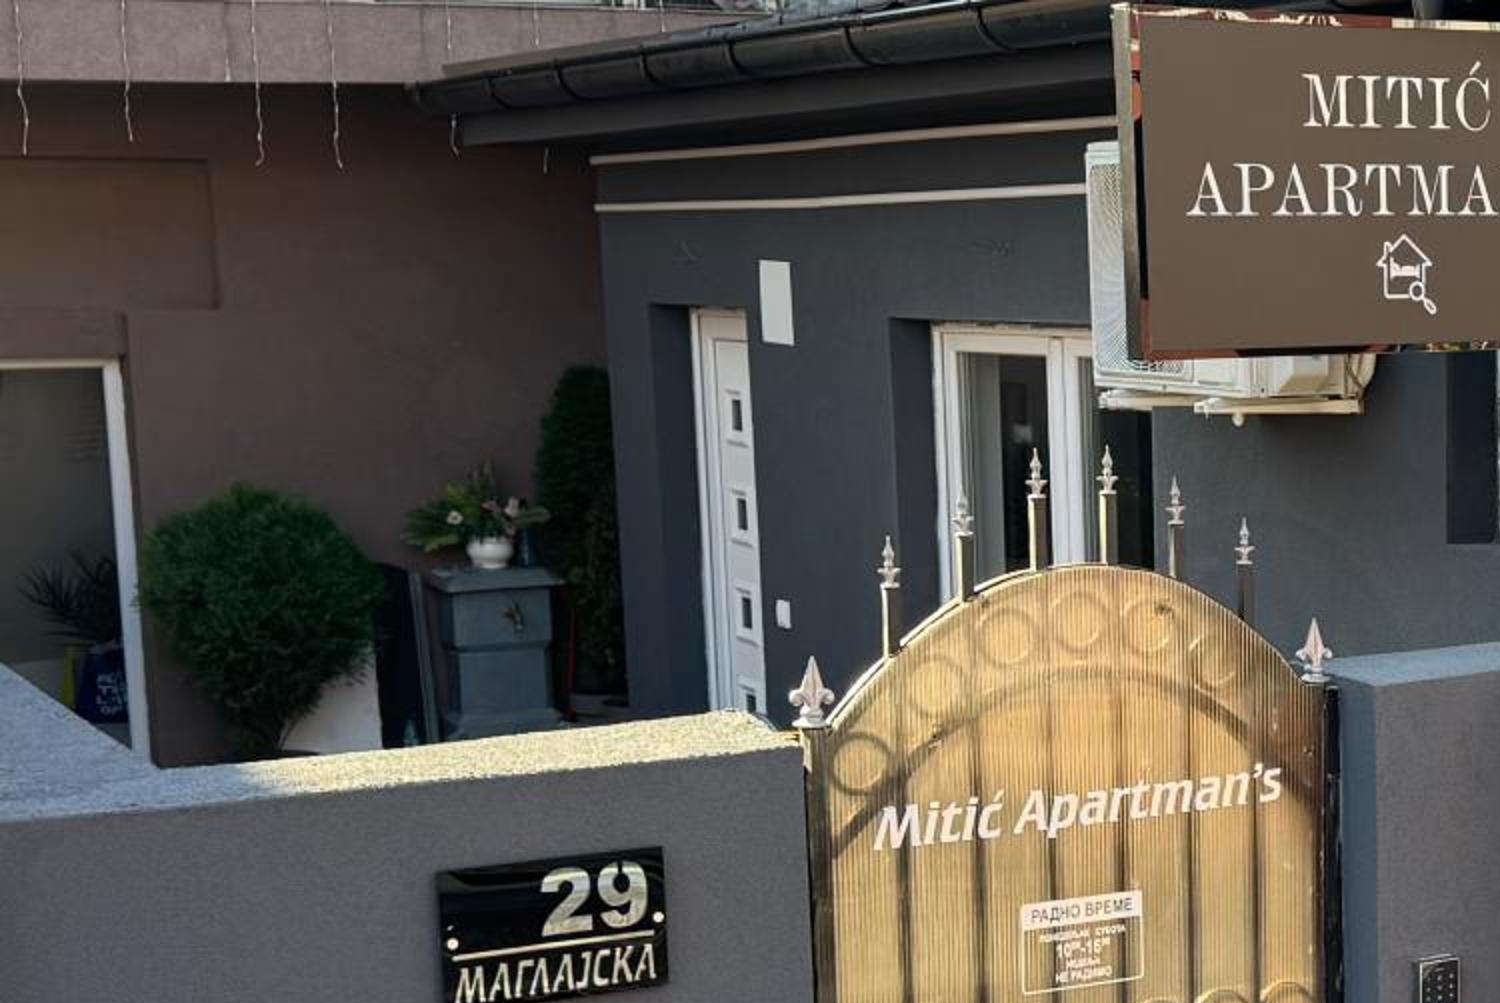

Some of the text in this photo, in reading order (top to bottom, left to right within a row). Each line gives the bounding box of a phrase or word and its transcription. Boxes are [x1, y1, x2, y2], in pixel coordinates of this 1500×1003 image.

[1302, 61, 1492, 131] MITIĆ
[873, 762, 1282, 851] Mitić Apartman's
[540, 860, 649, 937] 29
[1030, 896, 1133, 924] РАДНО ВРЕМЕ
